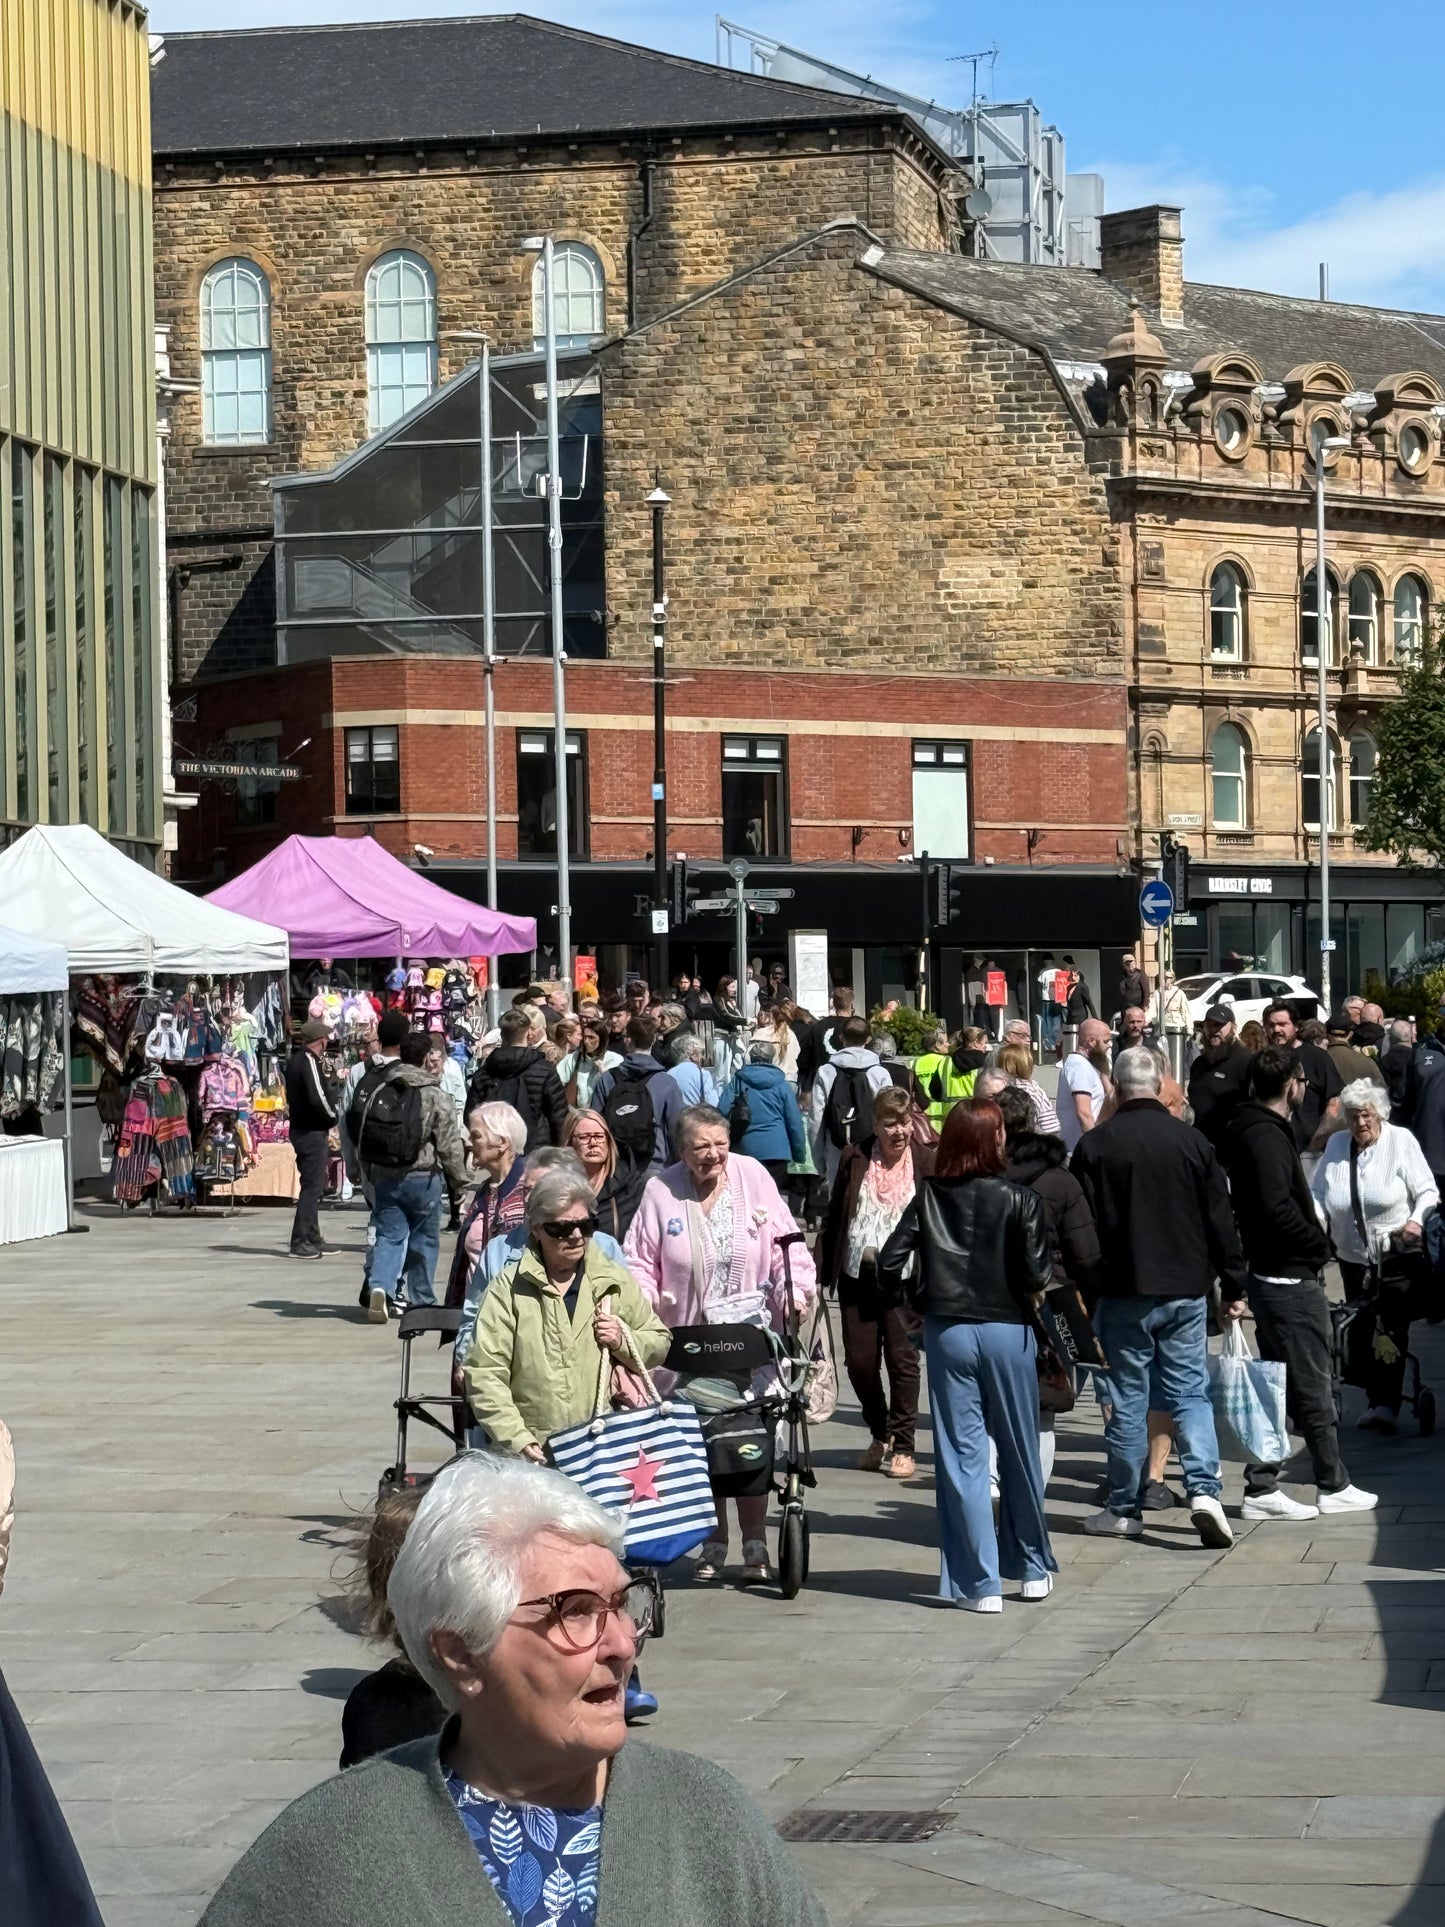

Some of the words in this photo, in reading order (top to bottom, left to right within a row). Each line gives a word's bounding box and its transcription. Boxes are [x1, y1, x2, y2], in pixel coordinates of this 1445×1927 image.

[180, 763, 200, 773] THE
[202, 764, 258, 776] VICTORIAN
[258, 767, 299, 778] ARCADE
[704, 1340, 745, 1353] helavo
